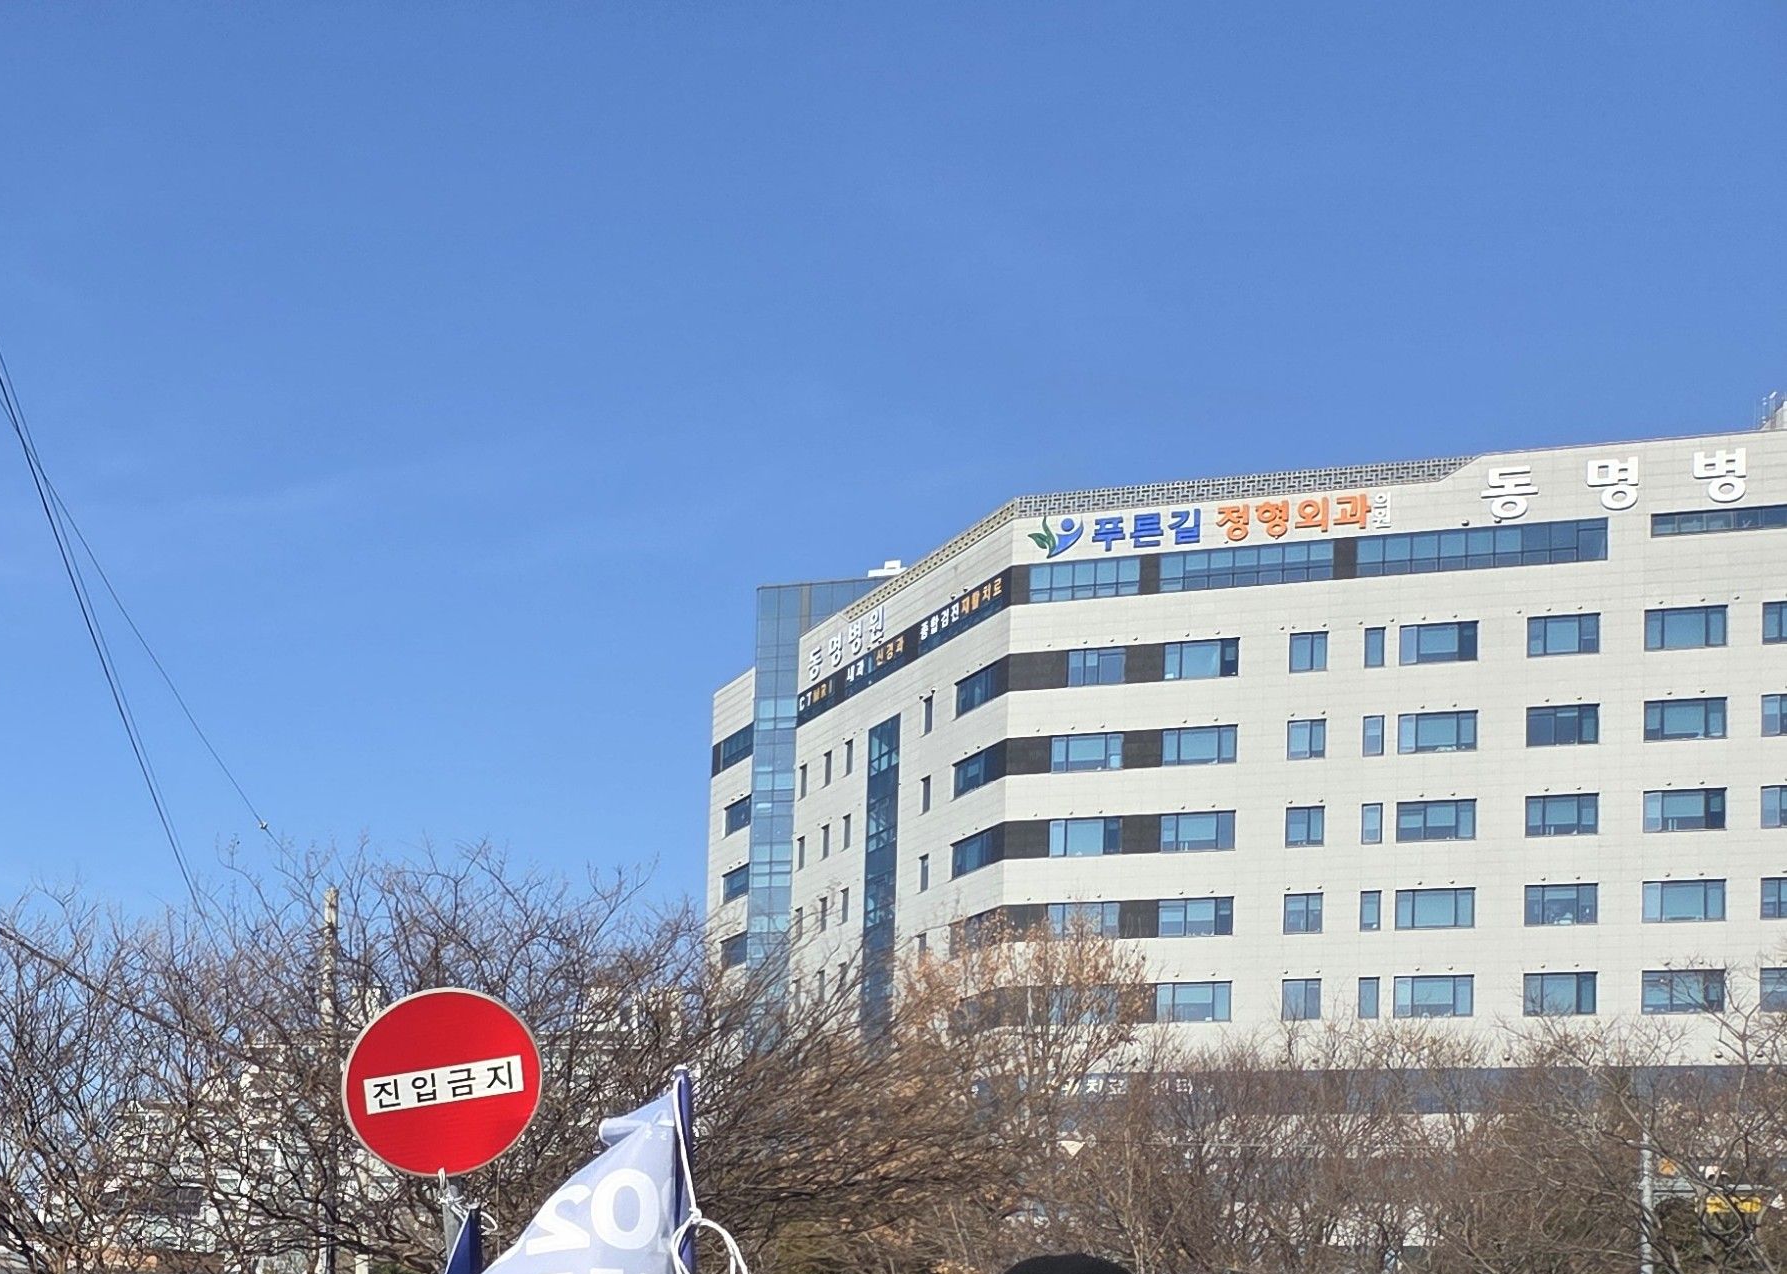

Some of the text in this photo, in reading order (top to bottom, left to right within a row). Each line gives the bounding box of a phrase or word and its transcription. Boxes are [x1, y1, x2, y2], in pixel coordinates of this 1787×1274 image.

[1091, 507, 1202, 553] 푸른길
[1215, 492, 1371, 542] 정형외과
[808, 604, 886, 682] 동명병원
[373, 1061, 514, 1110] 진입금지
